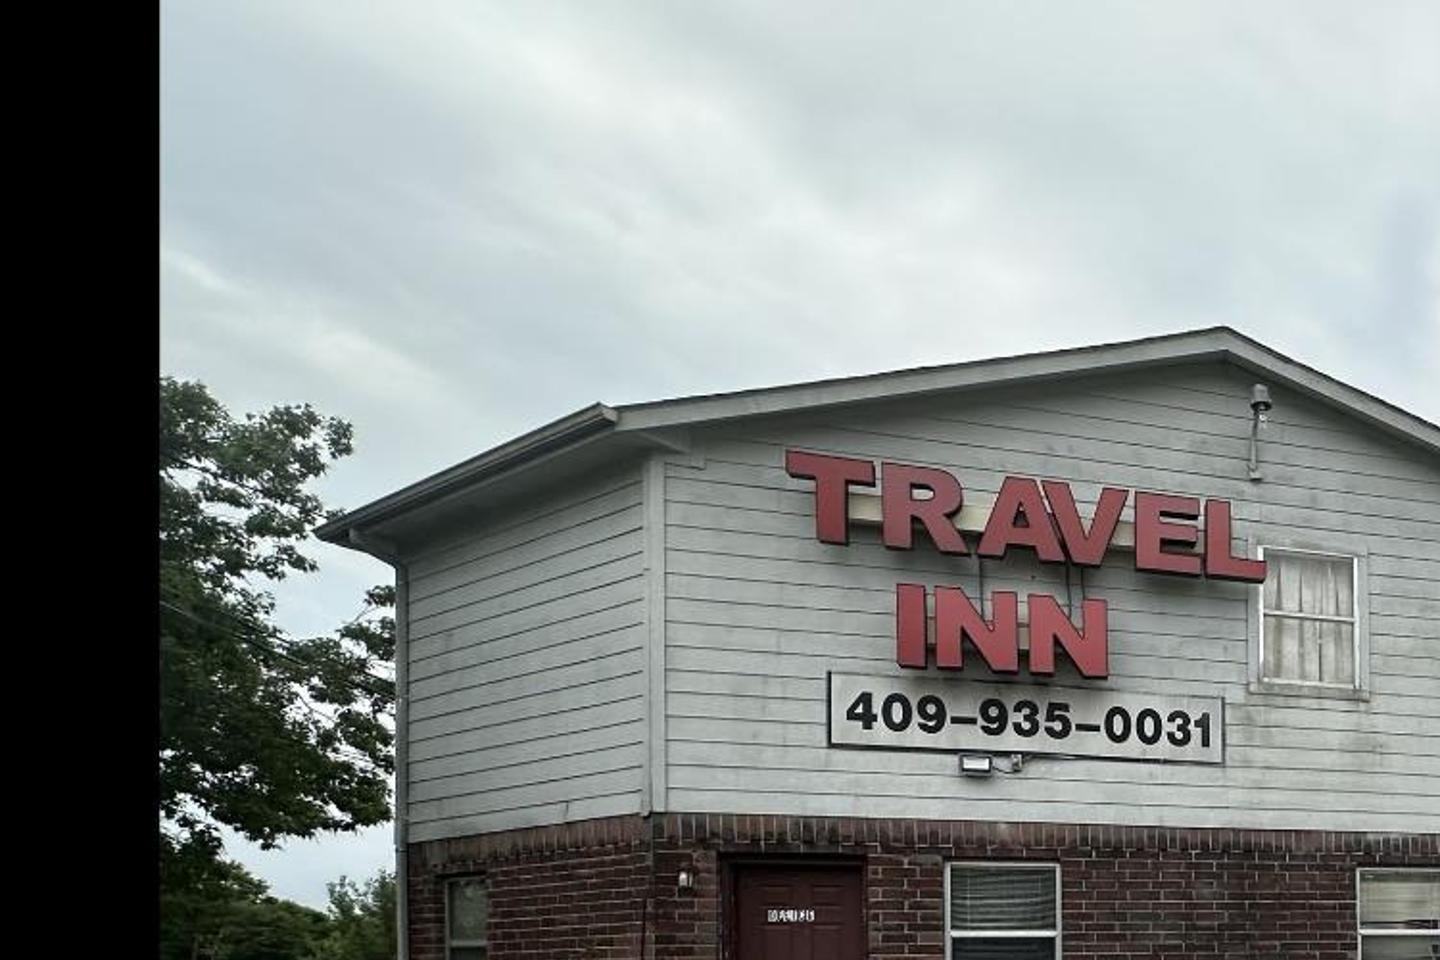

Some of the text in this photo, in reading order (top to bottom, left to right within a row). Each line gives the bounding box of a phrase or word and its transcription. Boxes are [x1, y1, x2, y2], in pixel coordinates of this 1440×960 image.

[785, 449, 1267, 582] TRAVEL
[896, 583, 1108, 678] INN
[846, 691, 1211, 748] 409-935-0031
